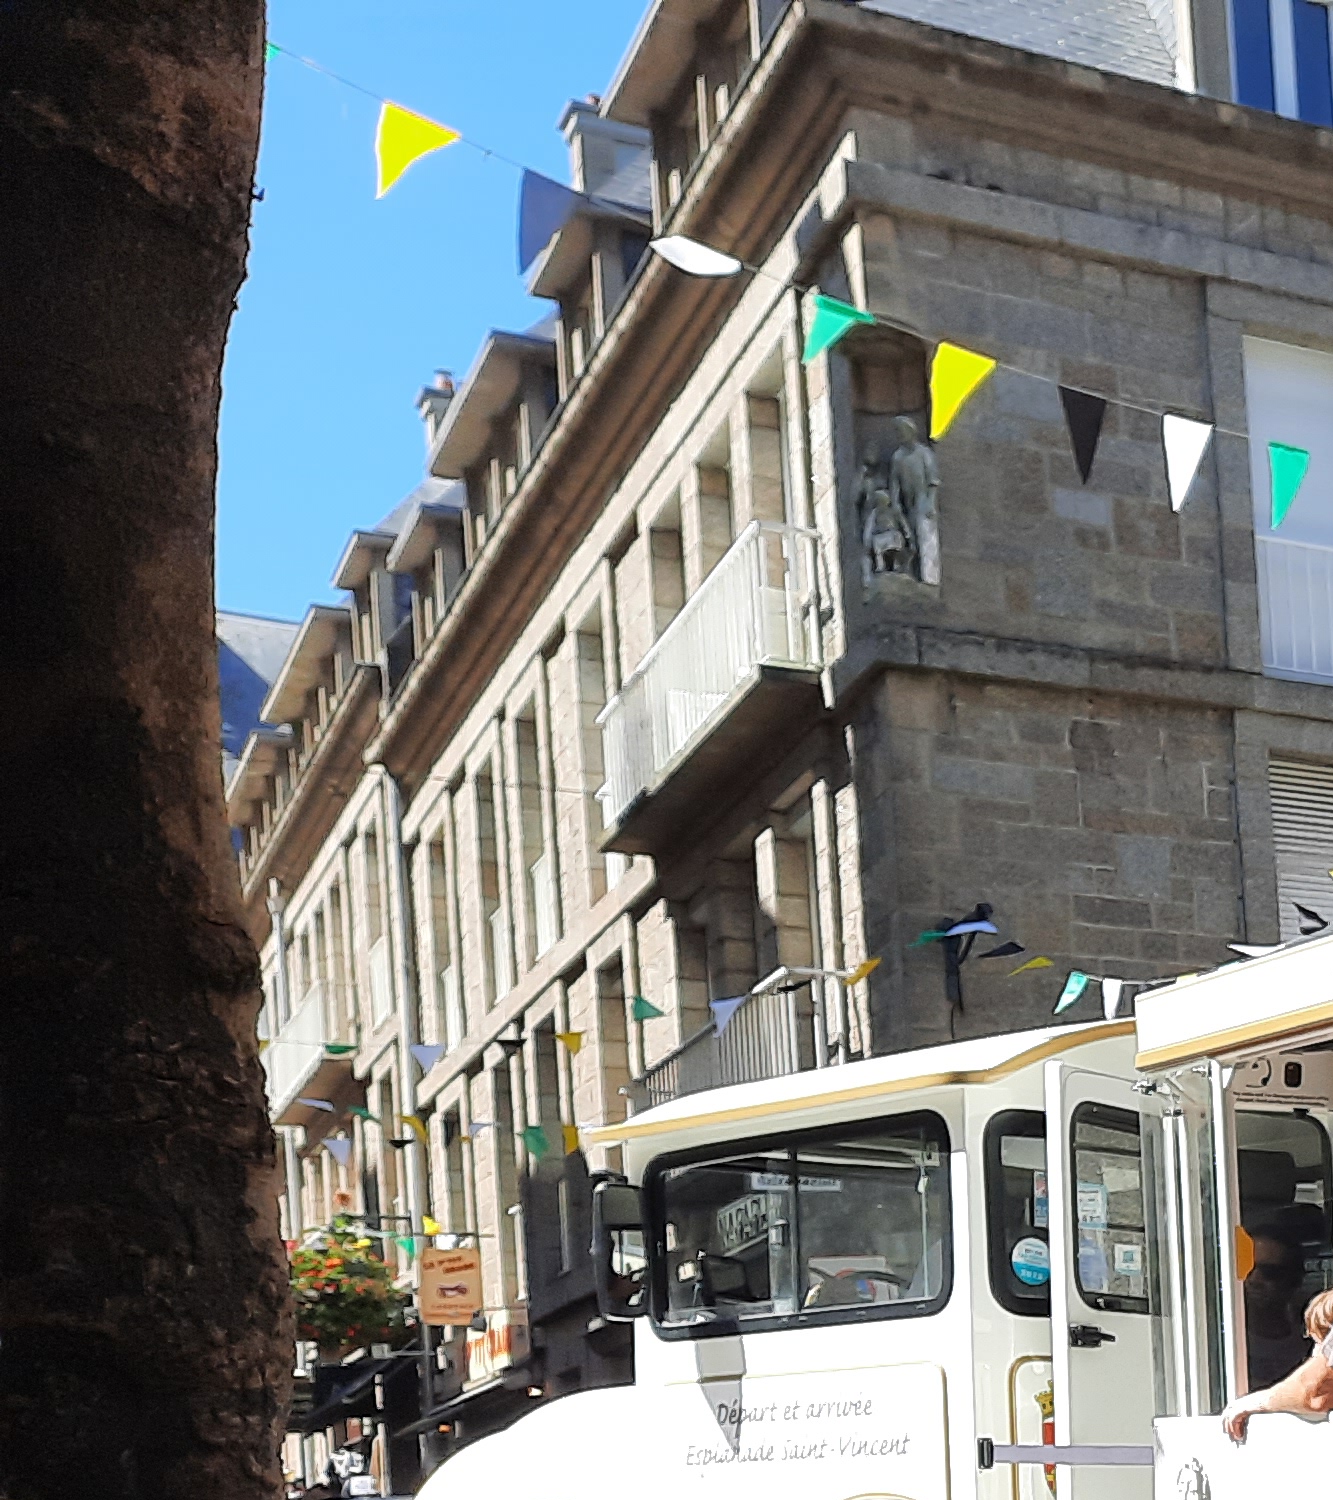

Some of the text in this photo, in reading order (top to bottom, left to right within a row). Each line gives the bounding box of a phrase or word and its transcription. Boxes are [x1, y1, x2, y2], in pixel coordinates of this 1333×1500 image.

[716, 1391, 874, 1439] Départ et arrivée
[686, 1437, 775, 1468] Esplanade
